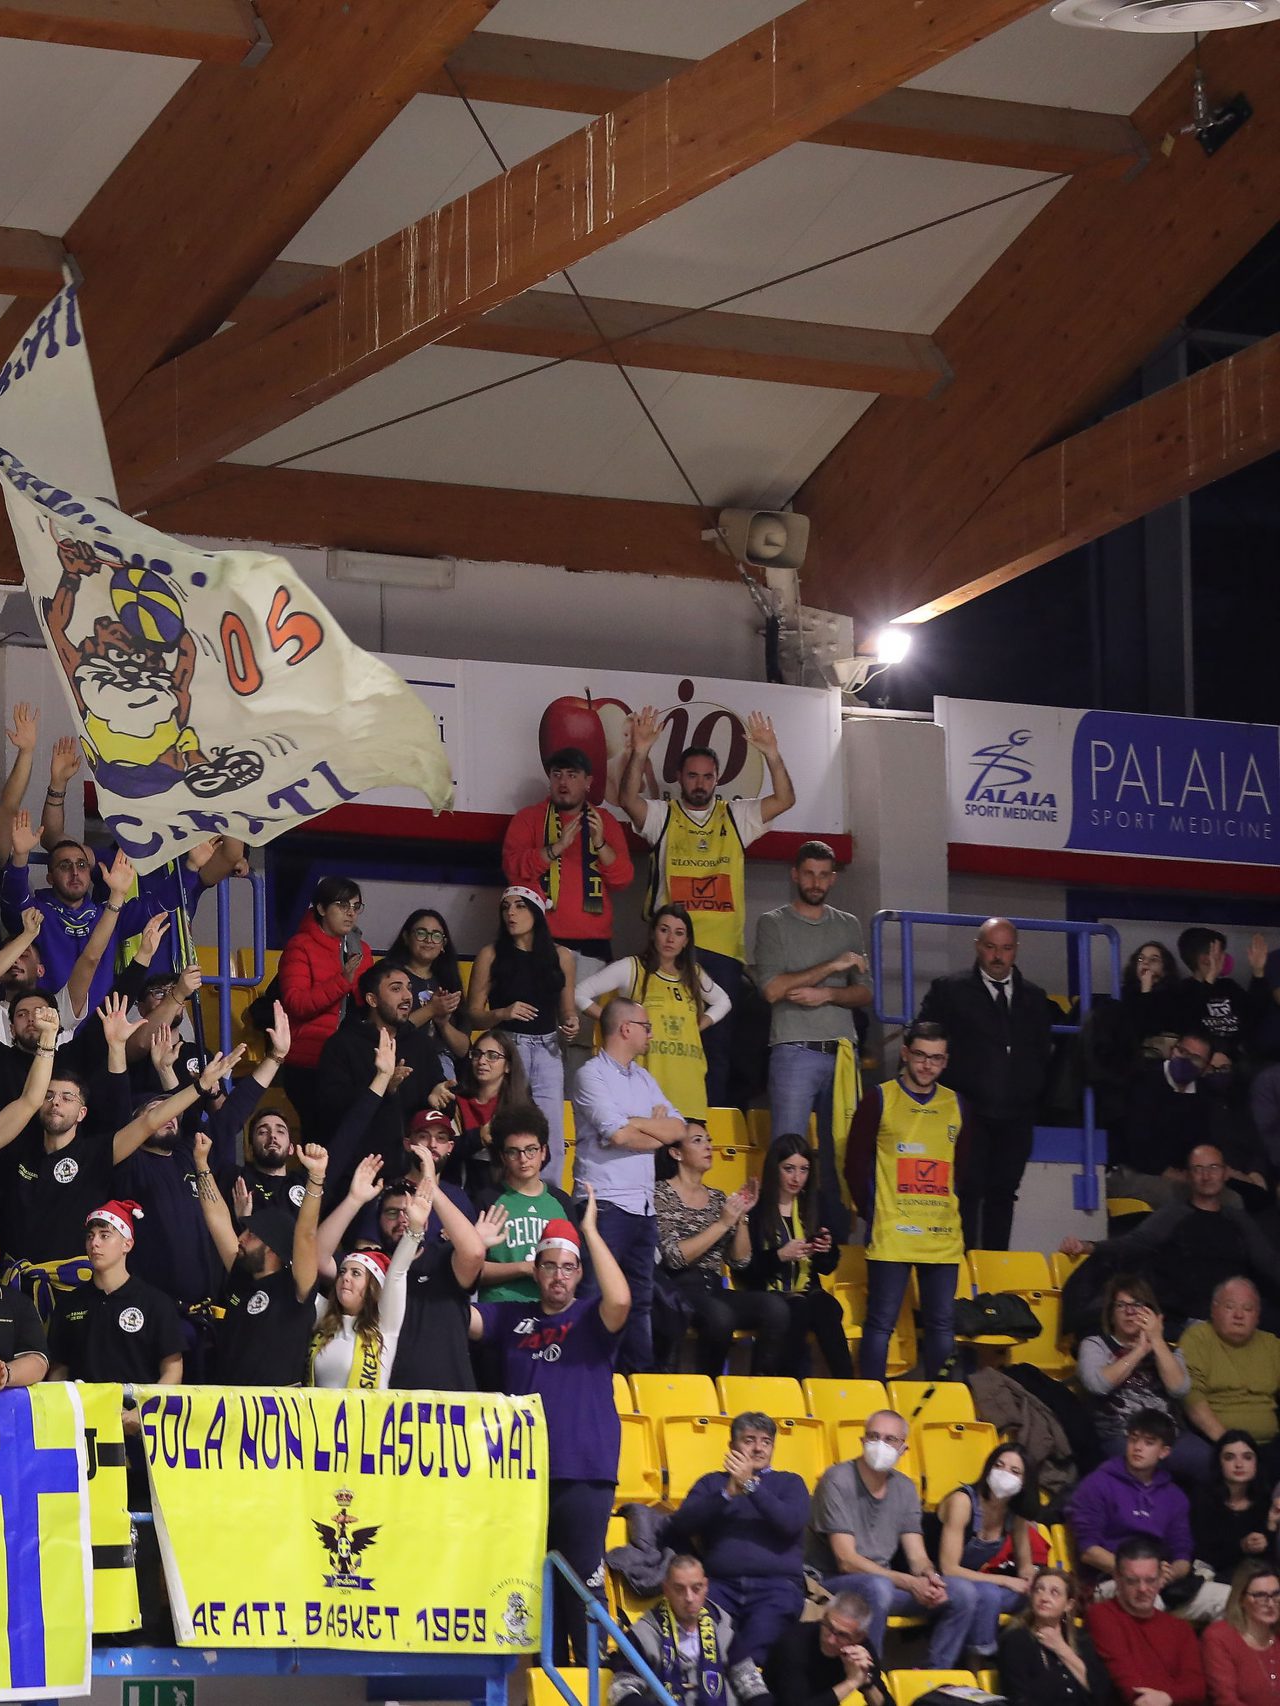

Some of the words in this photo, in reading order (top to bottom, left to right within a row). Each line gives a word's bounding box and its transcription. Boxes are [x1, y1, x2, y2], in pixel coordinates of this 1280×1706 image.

[1090, 740, 1272, 816] PALAIA
[964, 803, 1002, 819] SPORT
[1002, 806, 1058, 823] MEDICINE
[1090, 808, 1155, 830] SPORT
[1169, 817, 1272, 840] MEDICINE
[141, 1395, 226, 1469] SOLA
[239, 1395, 304, 1470] NON
[309, 1398, 349, 1473] LA
[360, 1399, 471, 1478] LASCIO
[481, 1407, 537, 1480] MAI
[305, 1602, 400, 1641] BASKET
[416, 1608, 487, 1643] 1969
